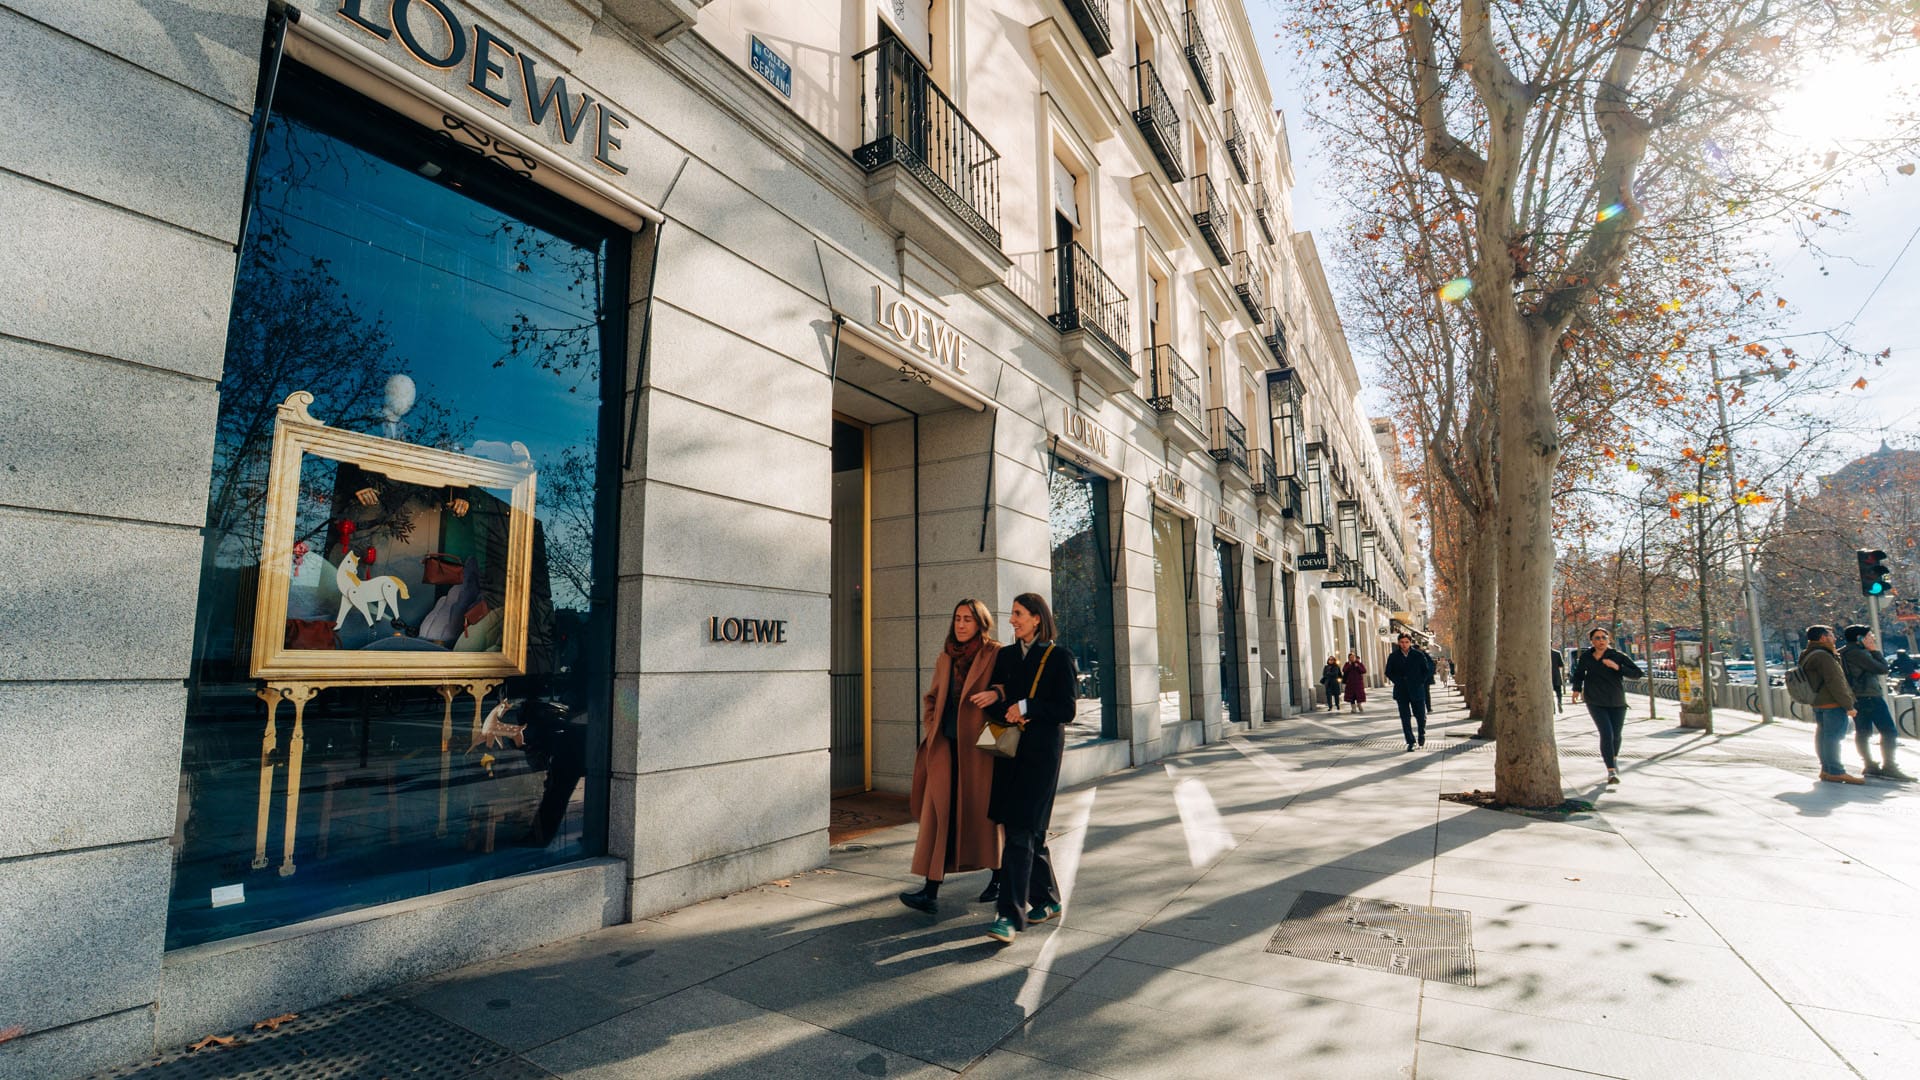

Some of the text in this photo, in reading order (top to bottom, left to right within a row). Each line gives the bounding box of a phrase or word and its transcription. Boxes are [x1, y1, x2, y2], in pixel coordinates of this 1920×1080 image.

[752, 55, 790, 97] SERRANO
[876, 284, 969, 376] LOEWE
[1298, 557, 1328, 567] LOEWE
[709, 615, 788, 646] LOEWE
